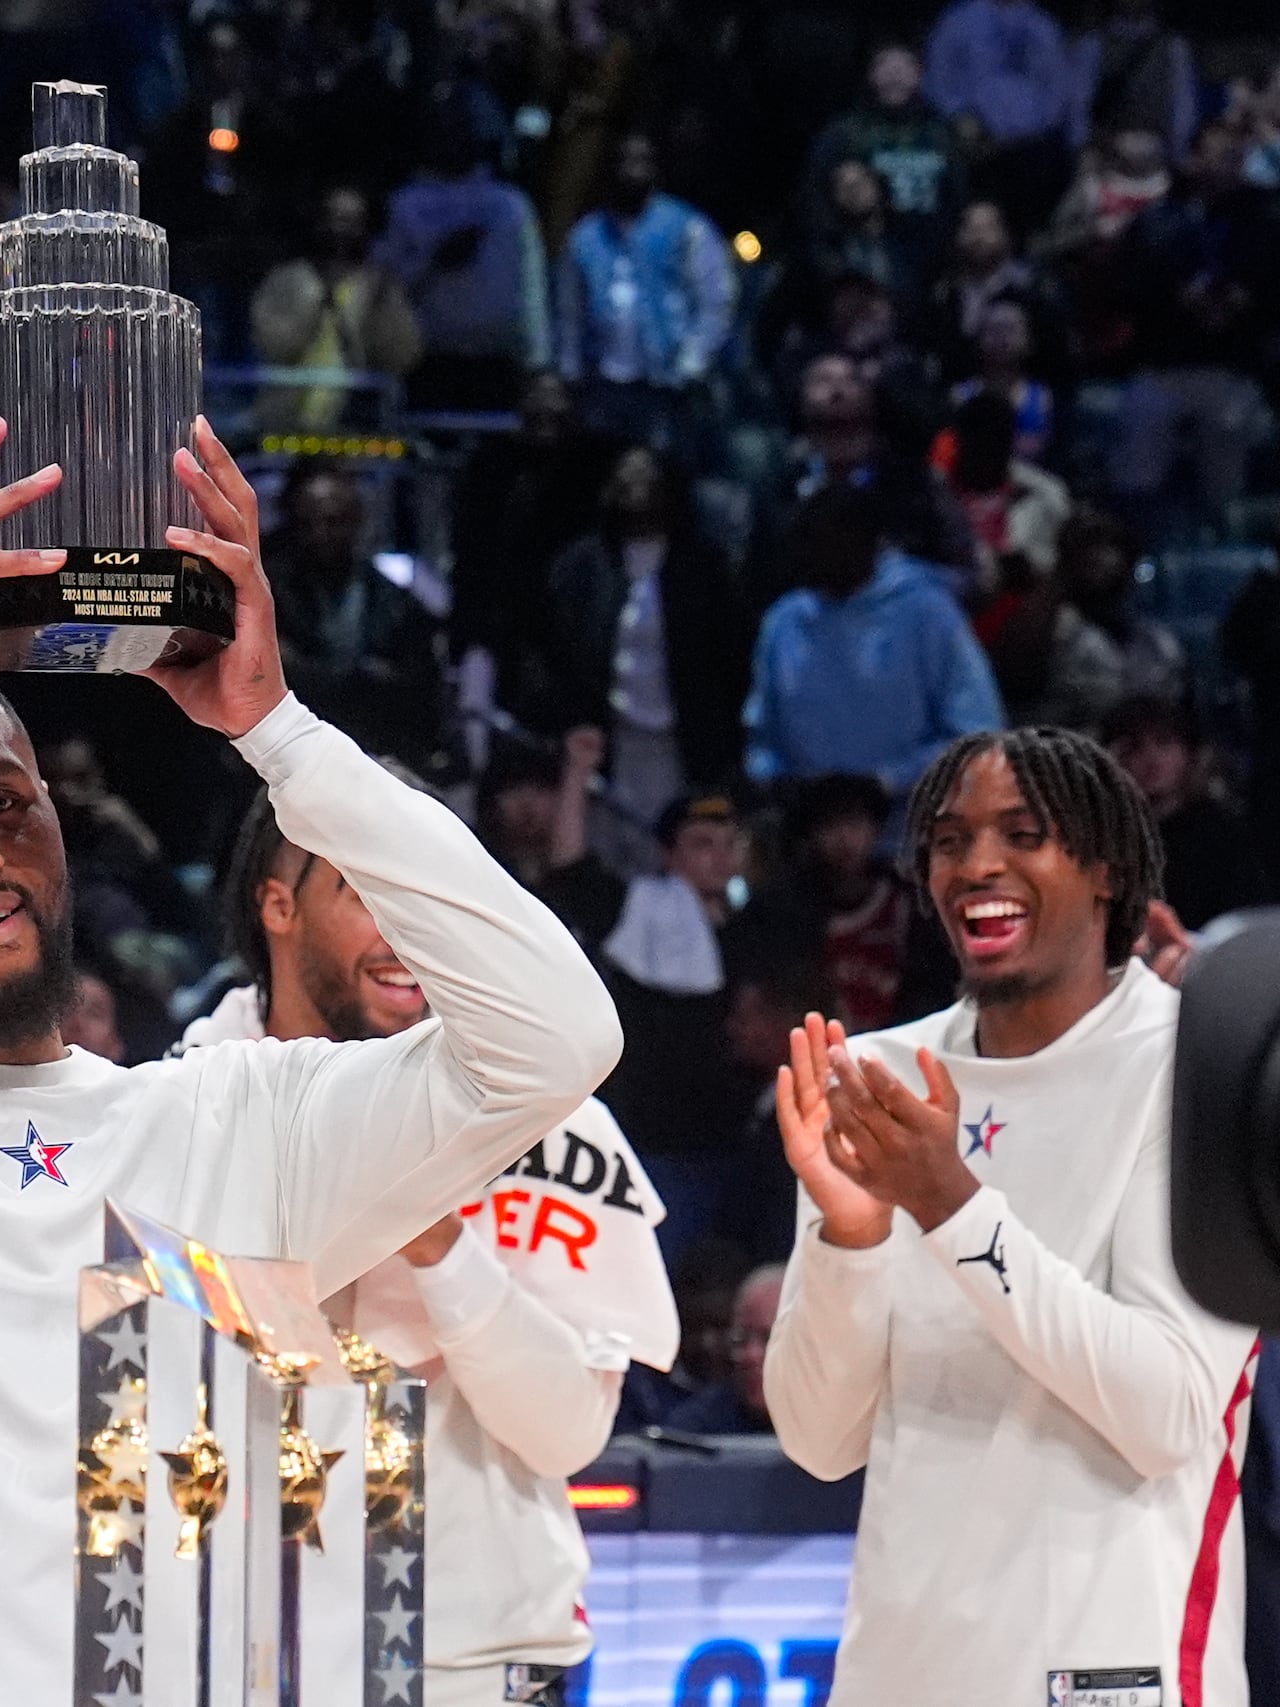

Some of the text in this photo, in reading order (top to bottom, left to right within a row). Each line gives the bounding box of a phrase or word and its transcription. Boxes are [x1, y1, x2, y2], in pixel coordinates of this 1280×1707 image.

[94, 552, 140, 565] KIA
[59, 572, 76, 586] THE
[104, 573, 138, 587] BRYANT
[140, 574, 175, 588] TROPHY
[62, 589, 173, 603] 2024 KIA NBA ALL-STAR GAME
[74, 604, 161, 617] MOST VALUABLE PLAYER
[458, 1187, 598, 1272] ER
